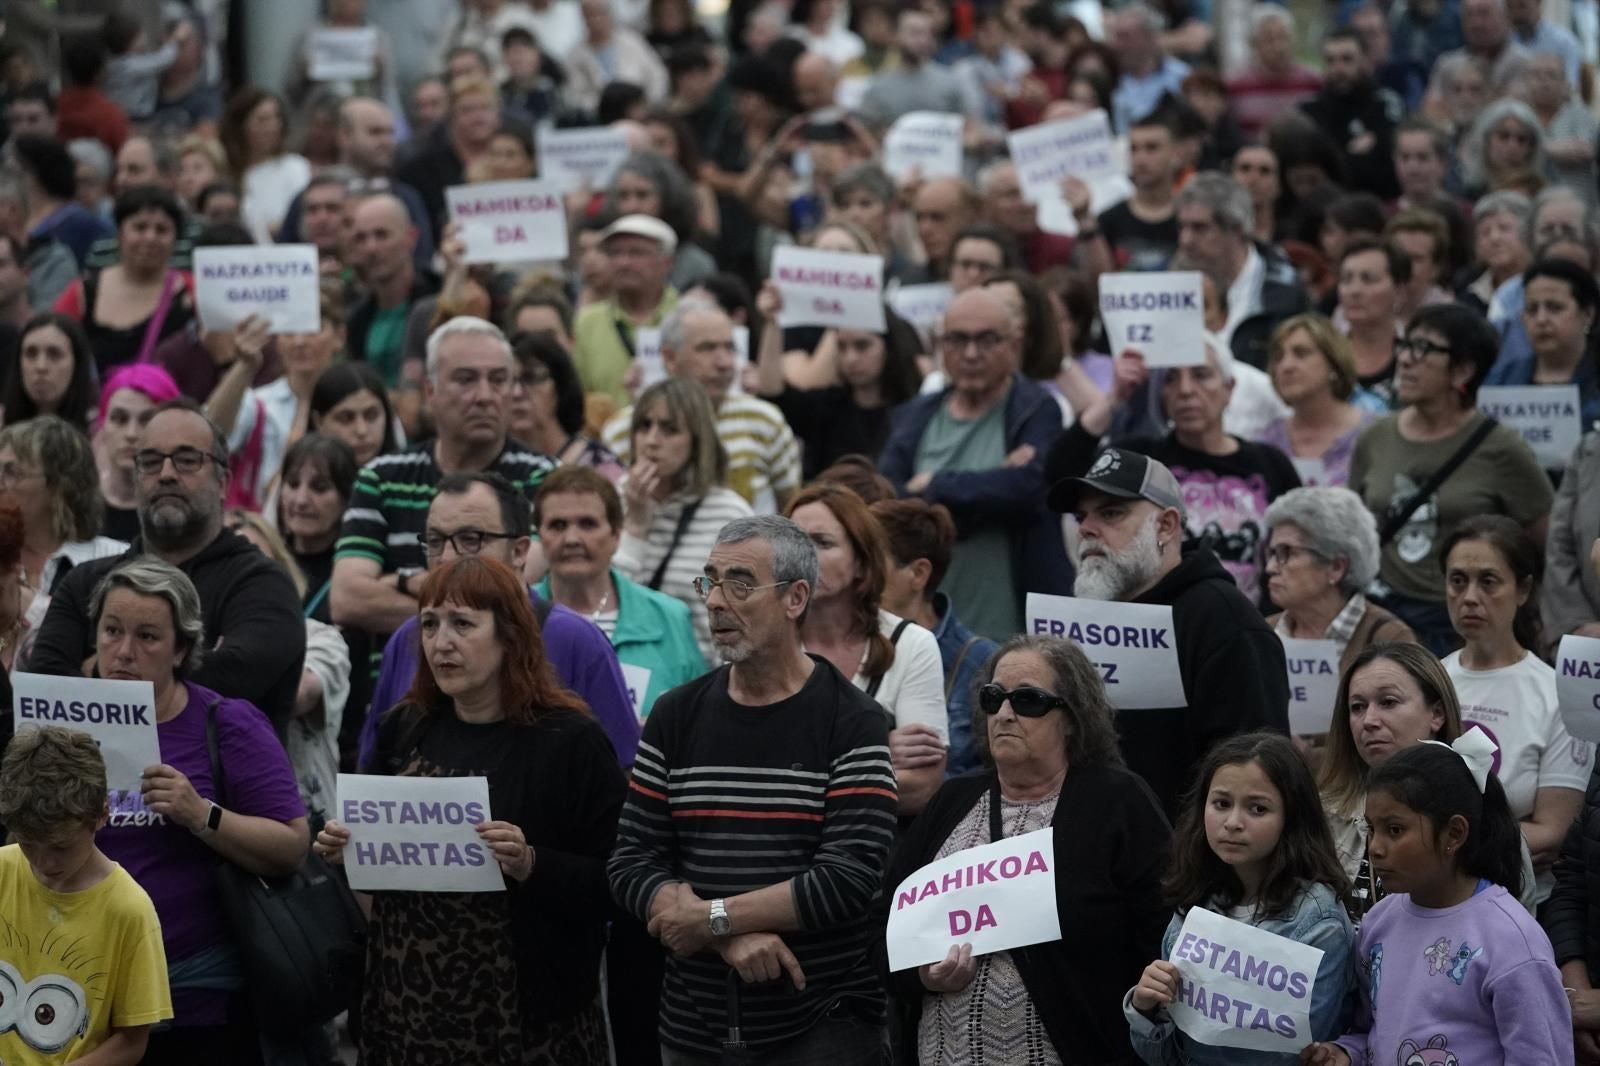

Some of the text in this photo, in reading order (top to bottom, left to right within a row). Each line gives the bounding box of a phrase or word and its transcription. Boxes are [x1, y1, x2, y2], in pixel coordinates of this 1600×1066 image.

[456, 196, 558, 216] NAHIKOA
[496, 225, 528, 243] DA
[1127, 325, 1152, 342] EZ
[1034, 618, 1169, 649] ERASORIK
[1093, 662, 1119, 684] Z
[1288, 658, 1333, 675] UTA
[20, 697, 150, 726] ERASORIK
[104, 806, 166, 827] tzen
[343, 800, 485, 825] ESTAMOS
[354, 841, 486, 867] HARTAS
[897, 850, 1049, 911] NAHIKOA
[948, 903, 998, 937] DA
[1175, 932, 1309, 999] ESTAMOS
[1178, 977, 1297, 1040] HARTAS
